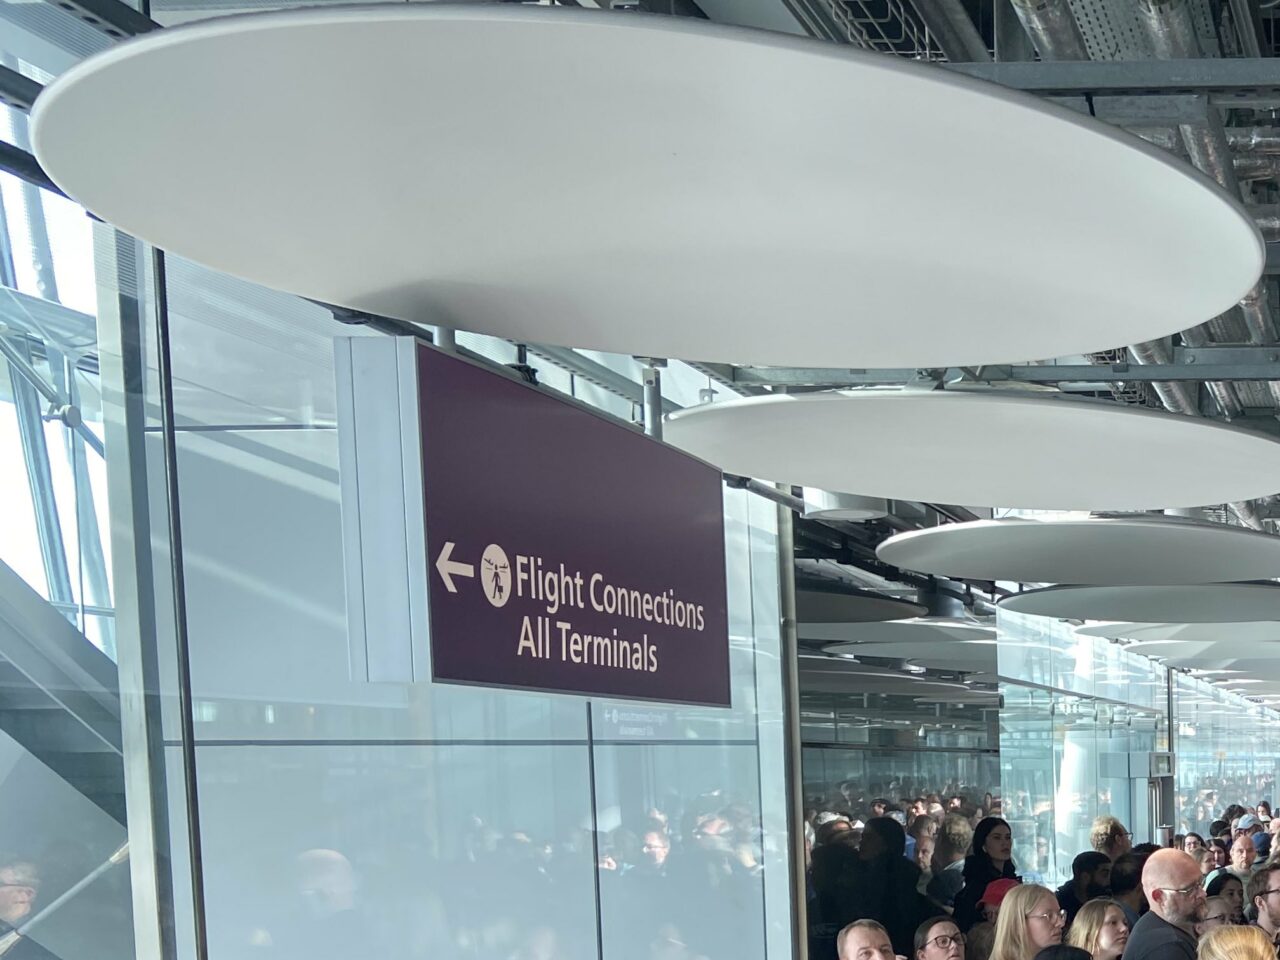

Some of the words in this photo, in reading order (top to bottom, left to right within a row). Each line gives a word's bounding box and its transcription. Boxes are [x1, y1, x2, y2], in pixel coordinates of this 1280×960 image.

[516, 555, 585, 614] Flight
[589, 572, 705, 631] Connections
[517, 615, 550, 659] All
[556, 621, 658, 673] Terminals
